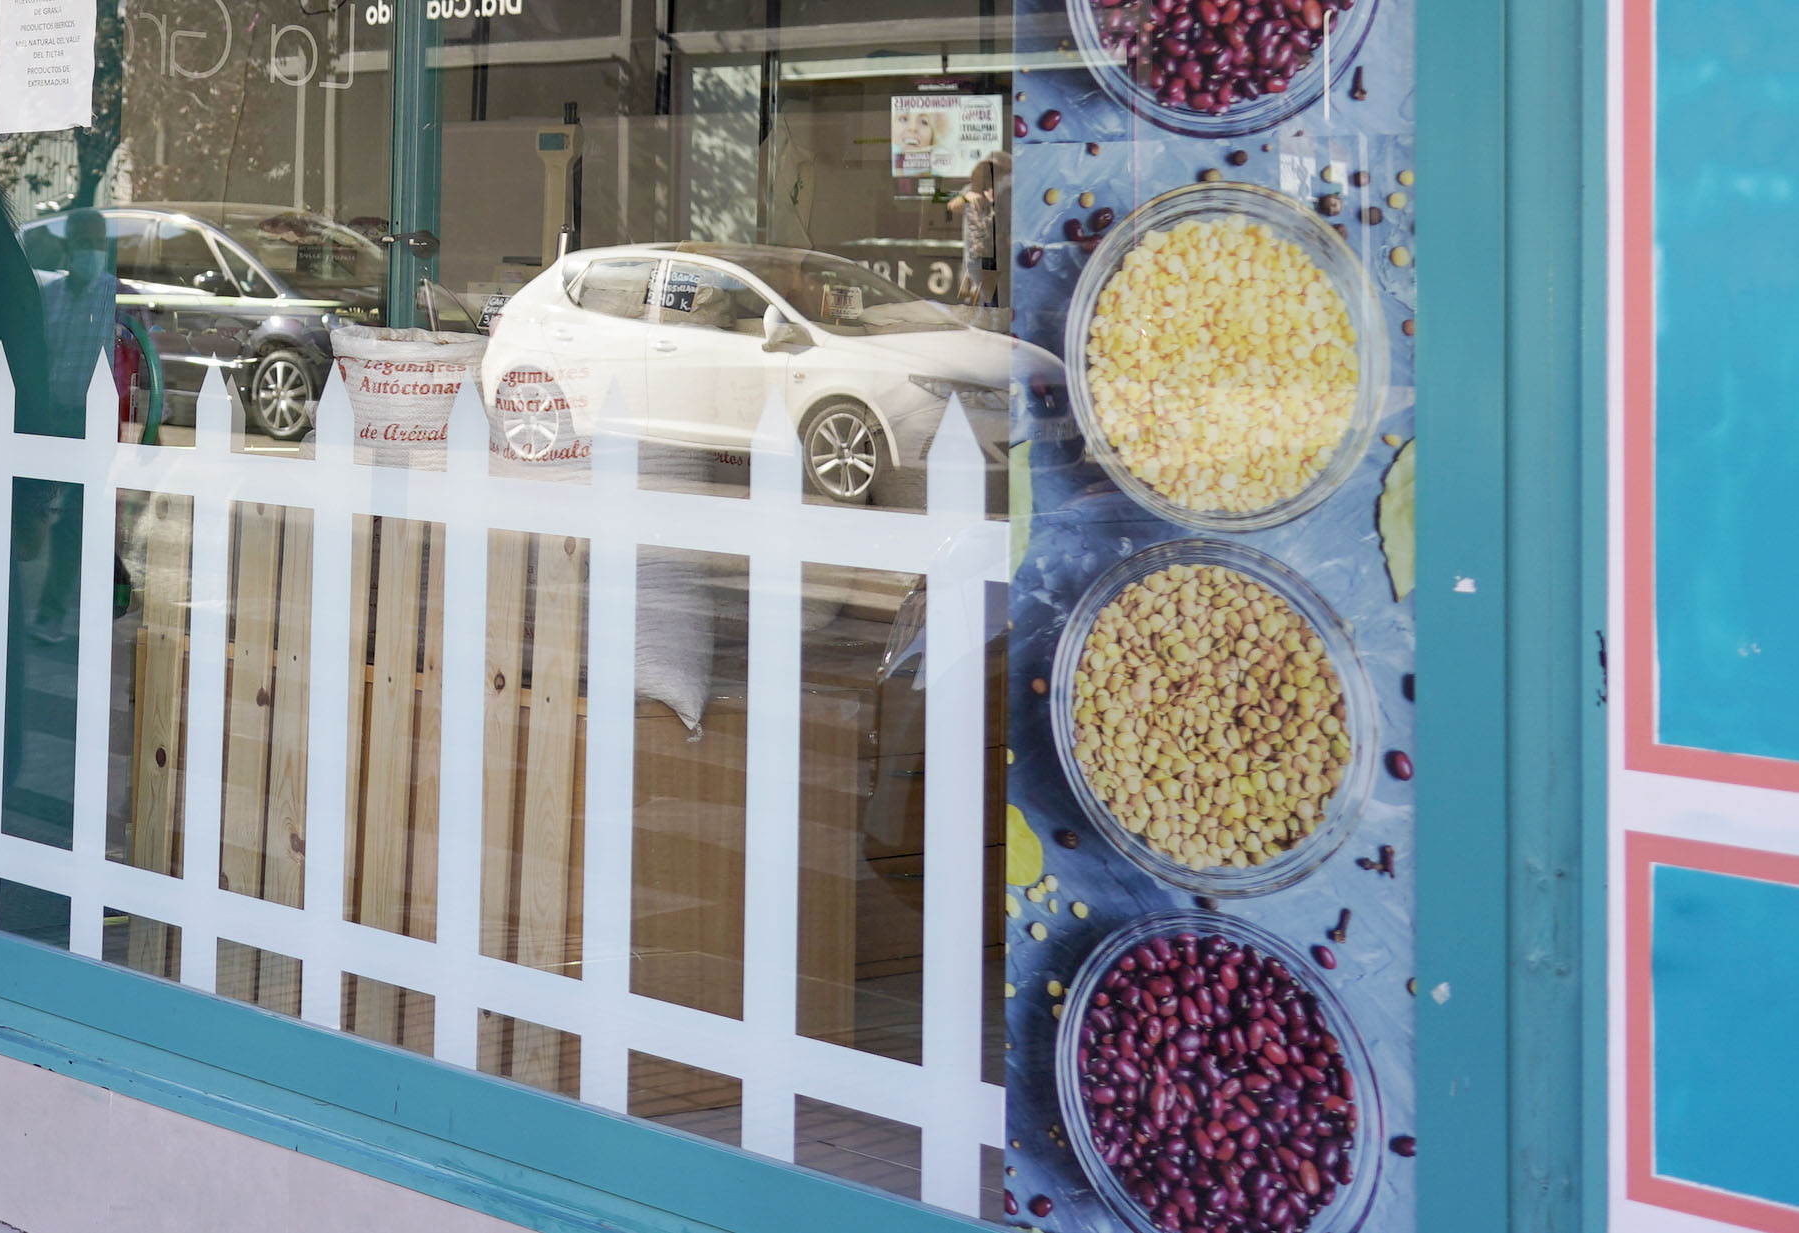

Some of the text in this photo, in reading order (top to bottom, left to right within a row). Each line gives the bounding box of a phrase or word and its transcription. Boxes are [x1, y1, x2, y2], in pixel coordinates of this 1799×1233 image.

[20, 23, 54, 31] PRODUCTOS
[28, 38, 56, 46] NATURAL
[33, 51, 44, 59] DEL
[27, 66, 62, 75] PRODUCTOS
[28, 78, 69, 87] EXTREMADURA
[359, 423, 448, 441] de Aréval
